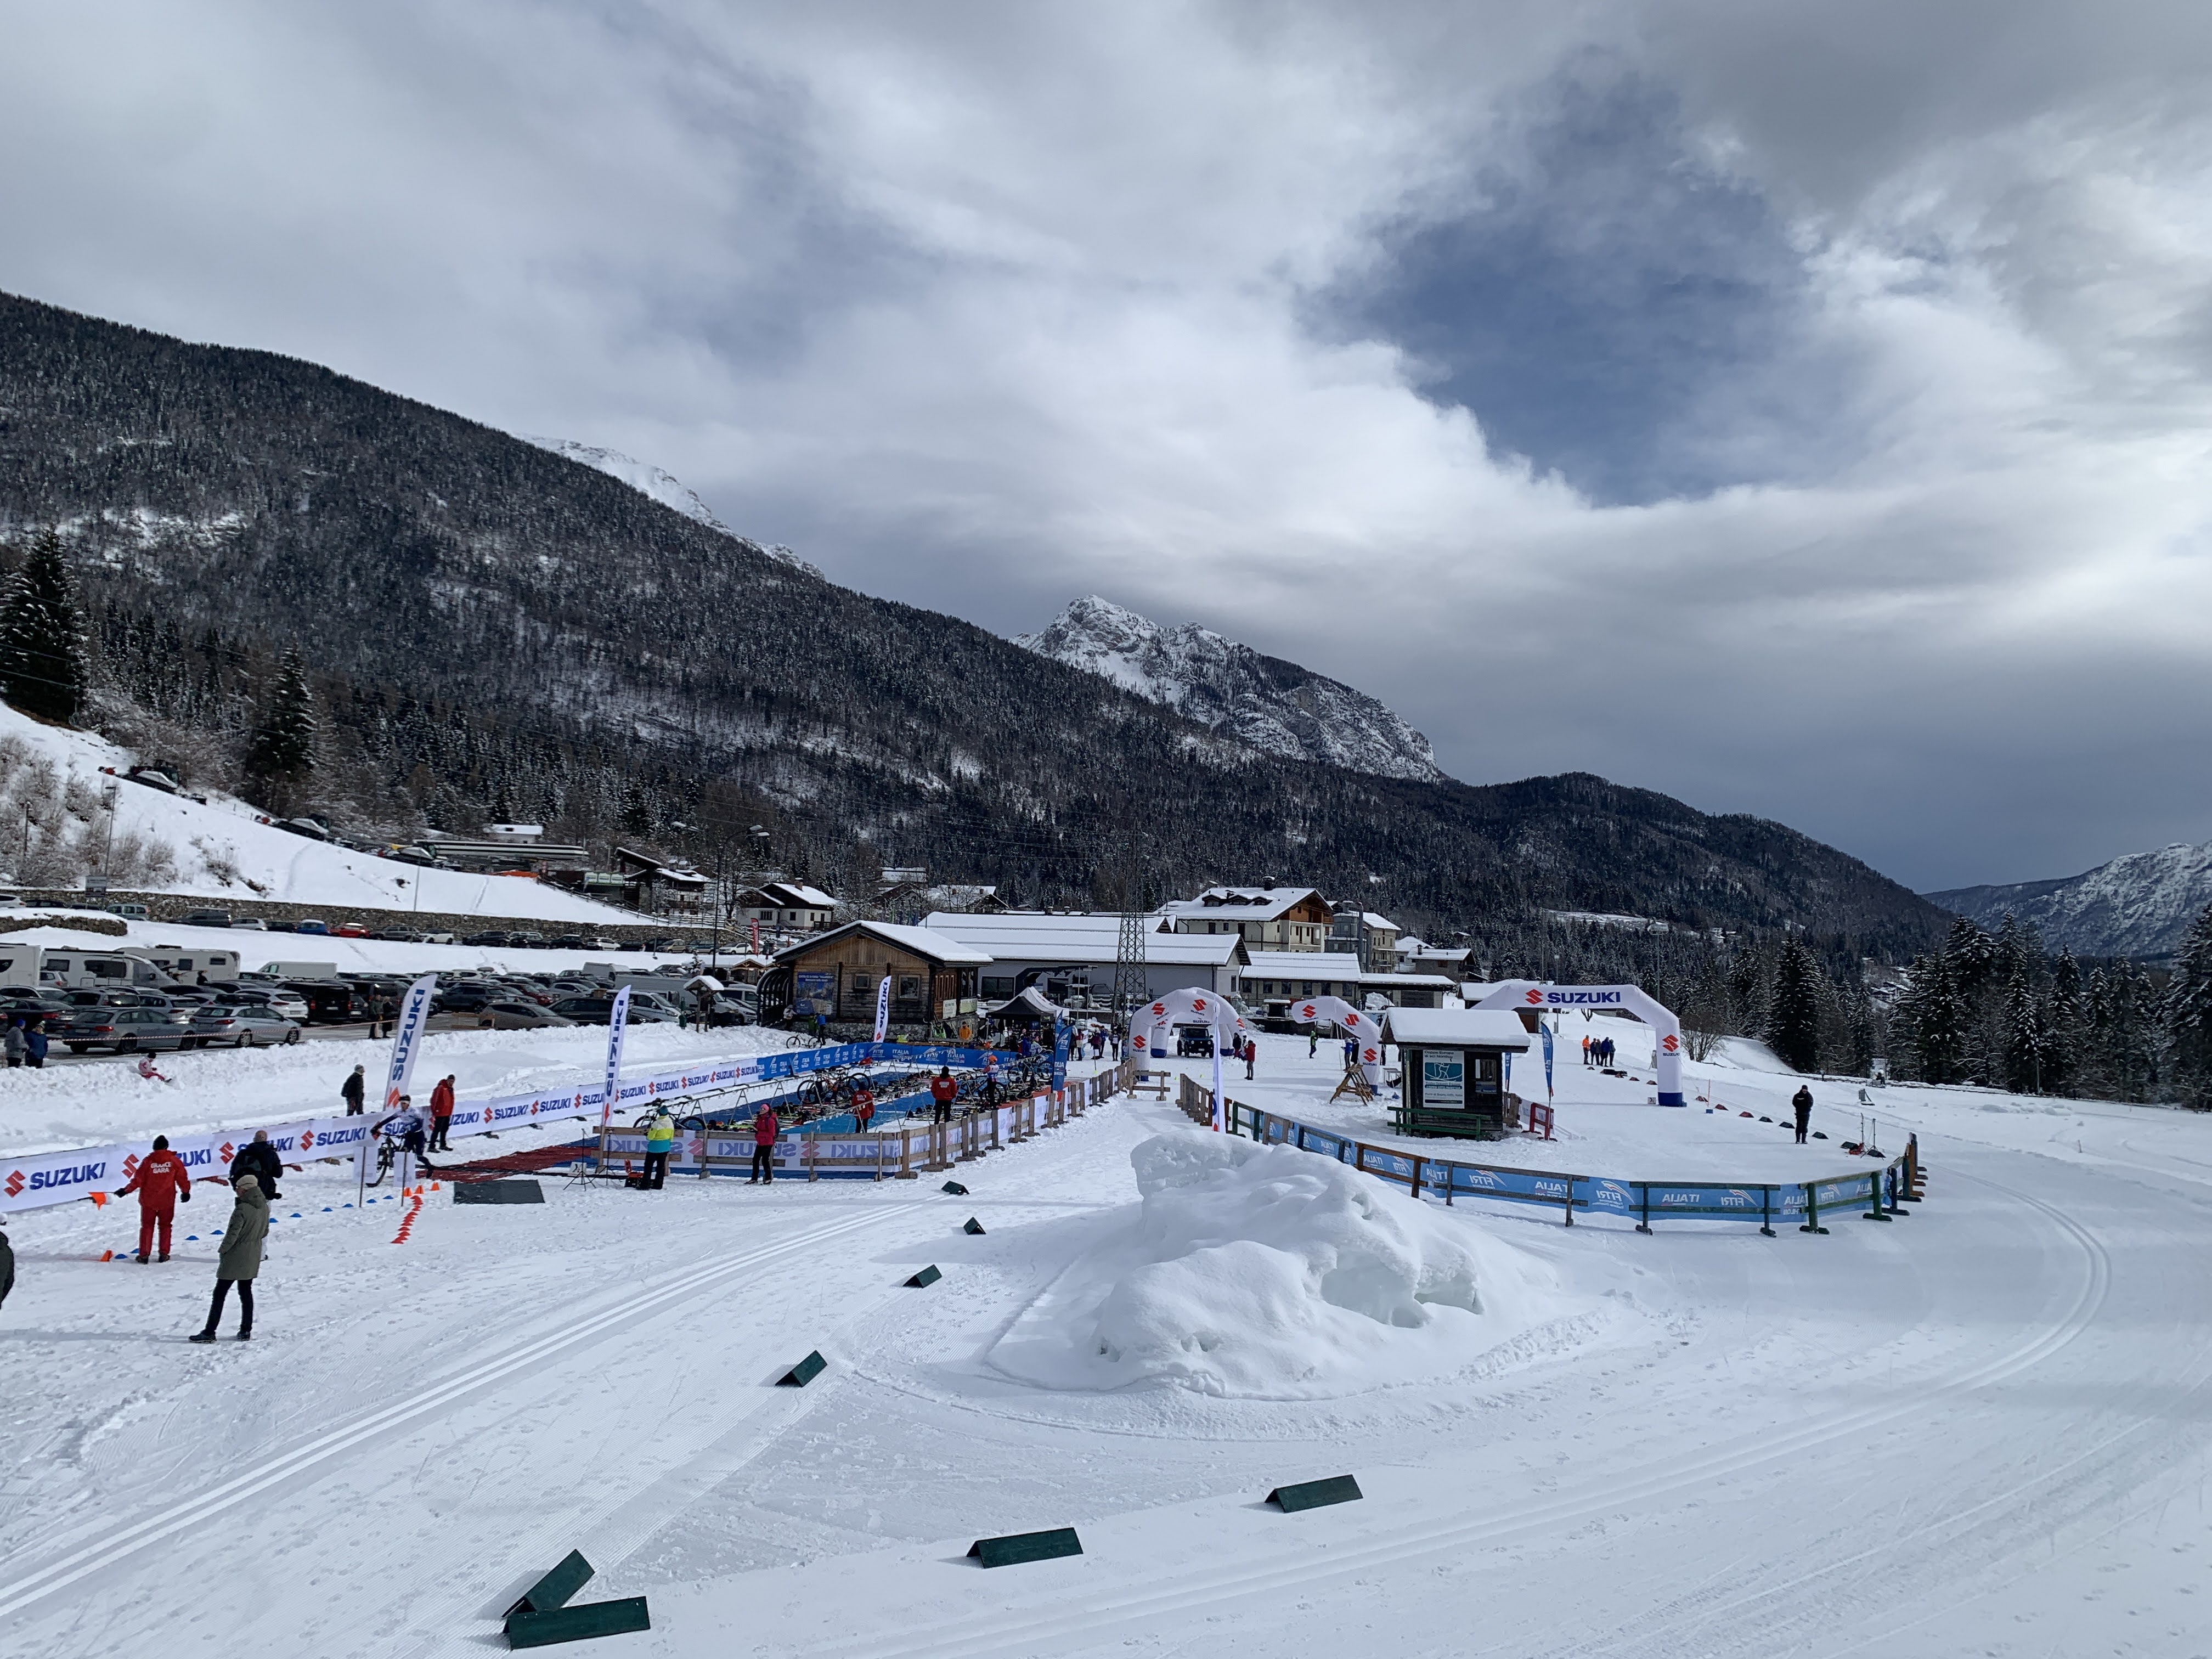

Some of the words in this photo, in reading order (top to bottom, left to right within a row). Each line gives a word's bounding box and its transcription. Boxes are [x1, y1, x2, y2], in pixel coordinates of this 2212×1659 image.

[1547, 991, 1621, 1003] SUZUKI
[392, 989, 426, 1081] SUZUKI
[687, 1074, 709, 1086] SUZUKI
[716, 1069, 735, 1081] SUZUKI
[620, 1085, 646, 1099] SUZUKI
[656, 1080, 679, 1092] SUZUKI
[539, 1098, 571, 1112] SUZUKI
[583, 1093, 603, 1105] SUZU
[494, 1104, 529, 1120] SUZUKI
[316, 1127, 366, 1147] SUZUKI
[29, 1161, 106, 1190] SUZUKI
